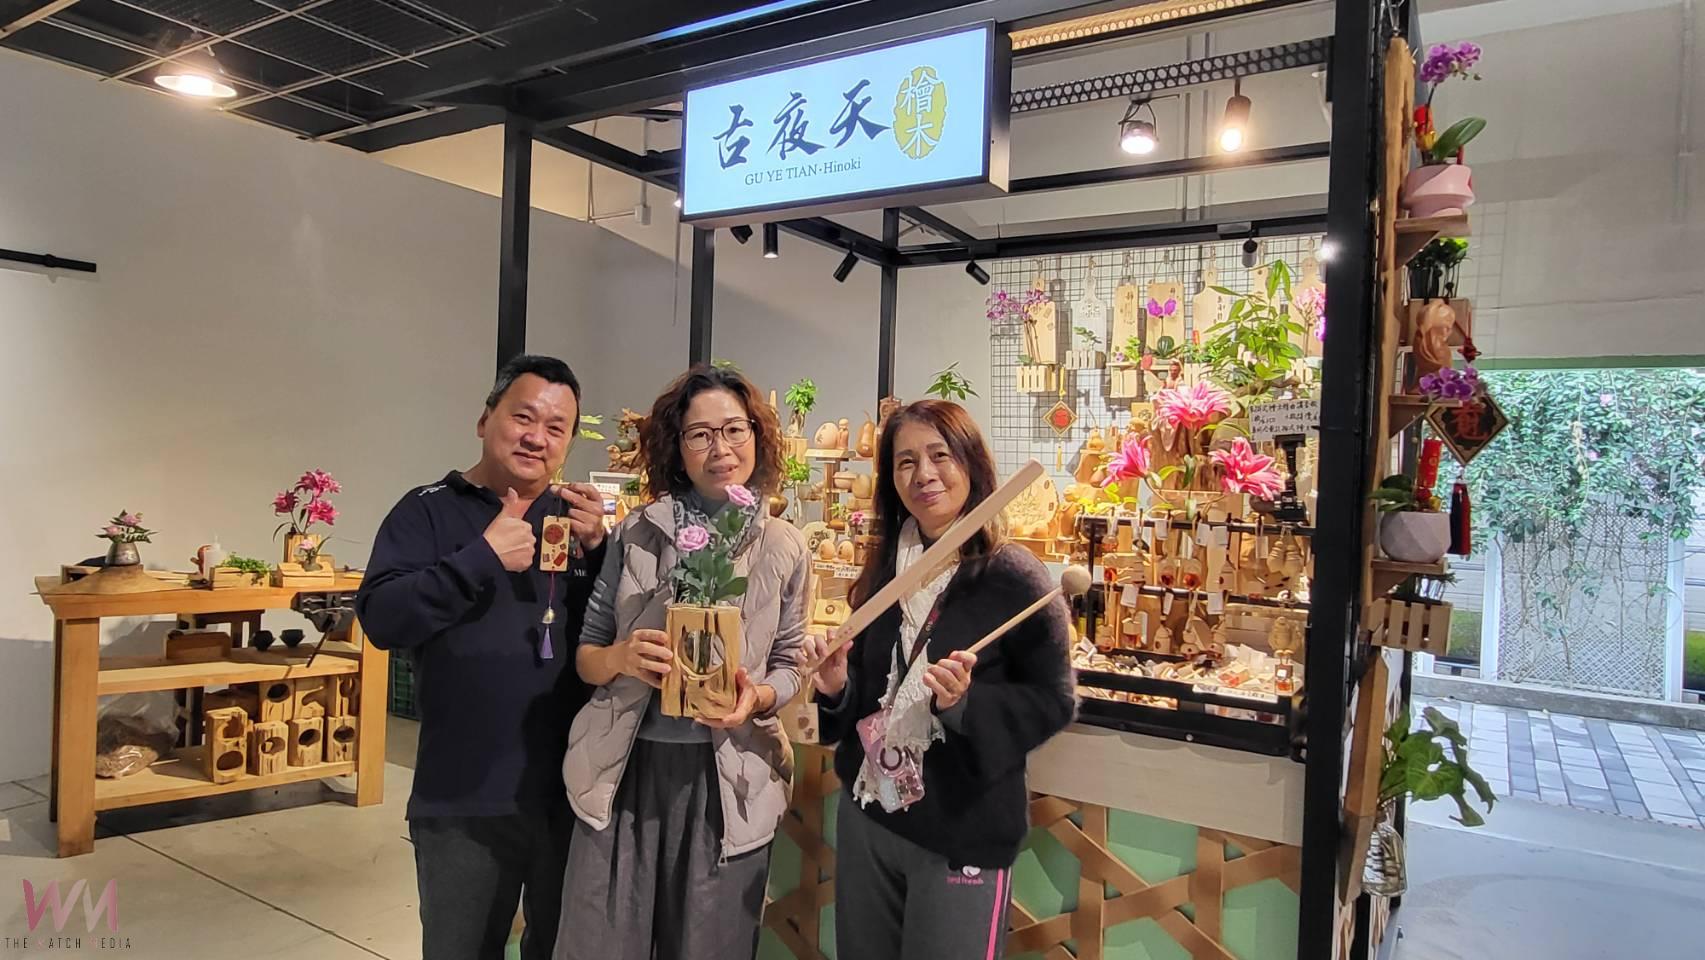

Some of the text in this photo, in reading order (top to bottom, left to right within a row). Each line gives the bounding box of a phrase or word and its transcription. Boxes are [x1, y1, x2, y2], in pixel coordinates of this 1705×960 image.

[713, 79, 892, 169] 古夜天
[899, 70, 942, 156] 檜木
[744, 172, 764, 186] GU
[766, 169, 783, 182] YE
